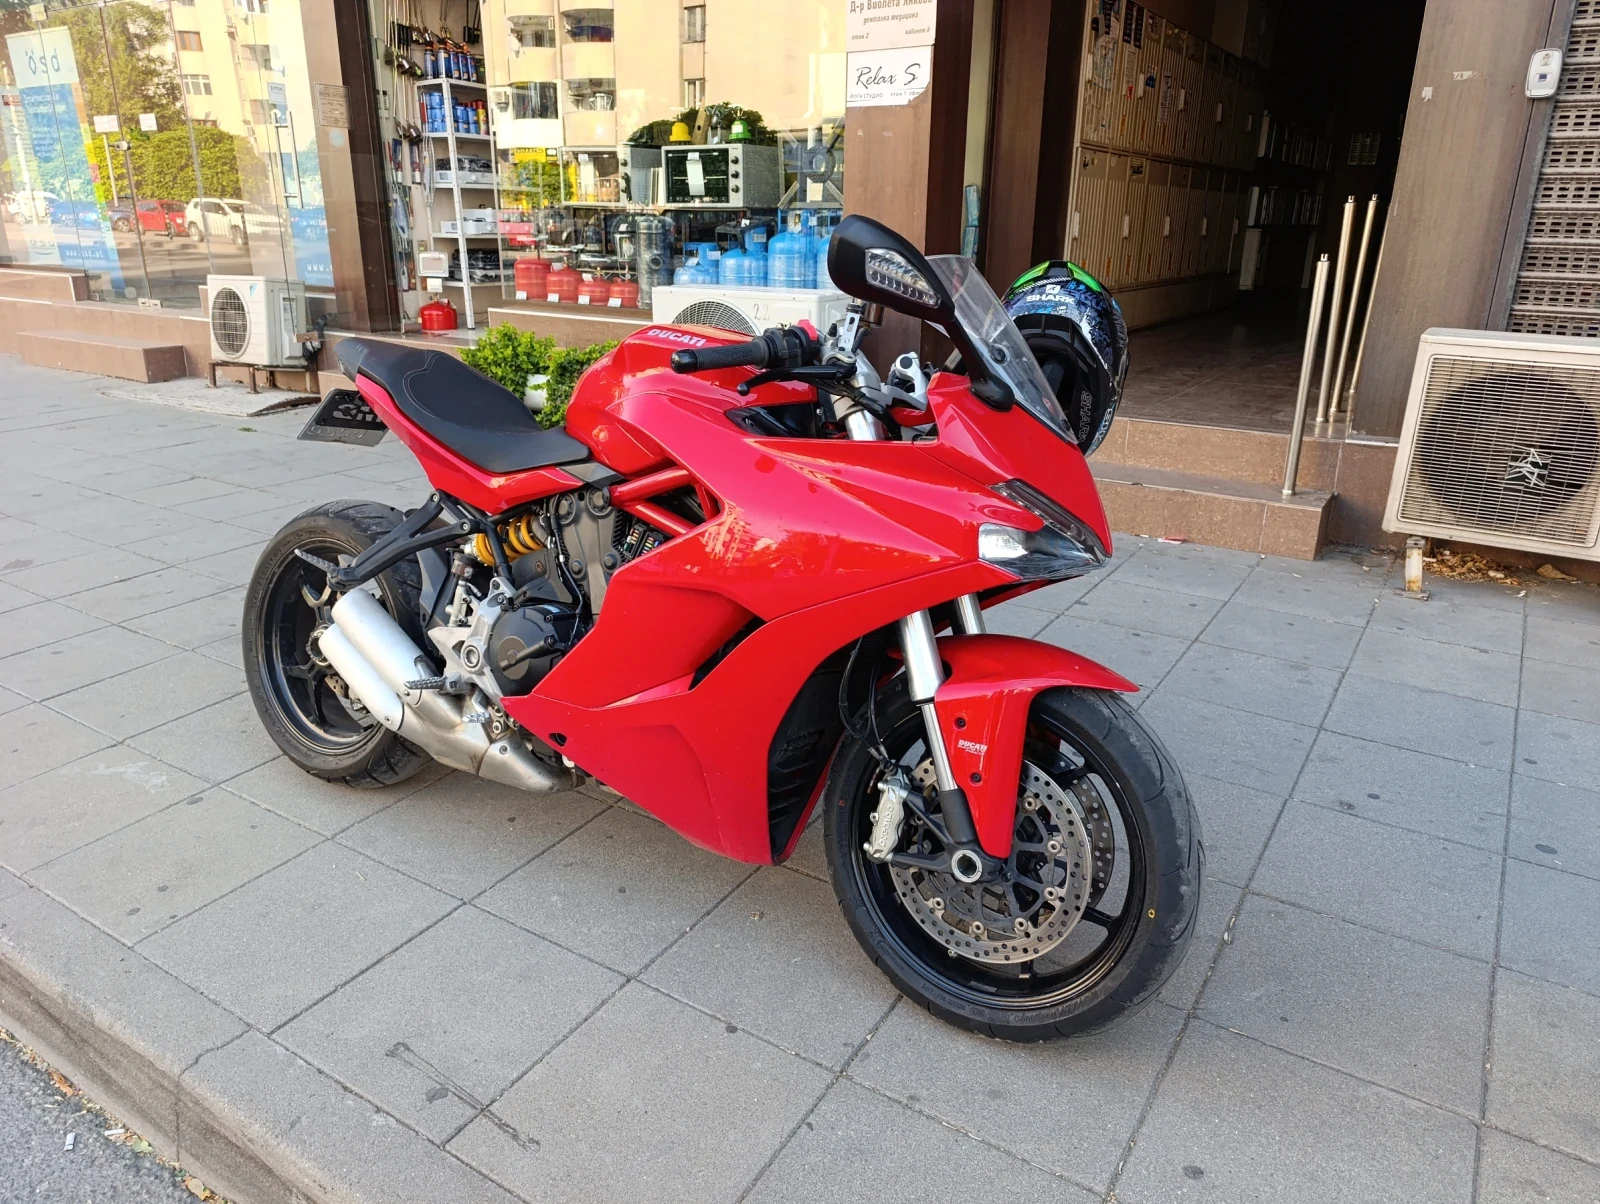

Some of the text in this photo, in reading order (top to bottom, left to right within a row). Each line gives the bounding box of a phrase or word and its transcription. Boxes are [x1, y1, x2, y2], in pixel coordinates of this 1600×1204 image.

[849, 0, 865, 14] Д-р
[866, 0, 901, 11] Виолета
[862, 11, 919, 26] дентална медицина
[904, 27, 926, 35] кабинет
[24, 48, 61, 76] ösd
[855, 62, 921, 89] Relax S
[863, 91, 884, 99] СТУДИО
[1025, 293, 1077, 305] SHARK
[646, 328, 707, 347] DUCATI
[1077, 390, 1093, 444] SHARK
[957, 739, 988, 752] DUCATI
[876, 804, 895, 848] brembo
